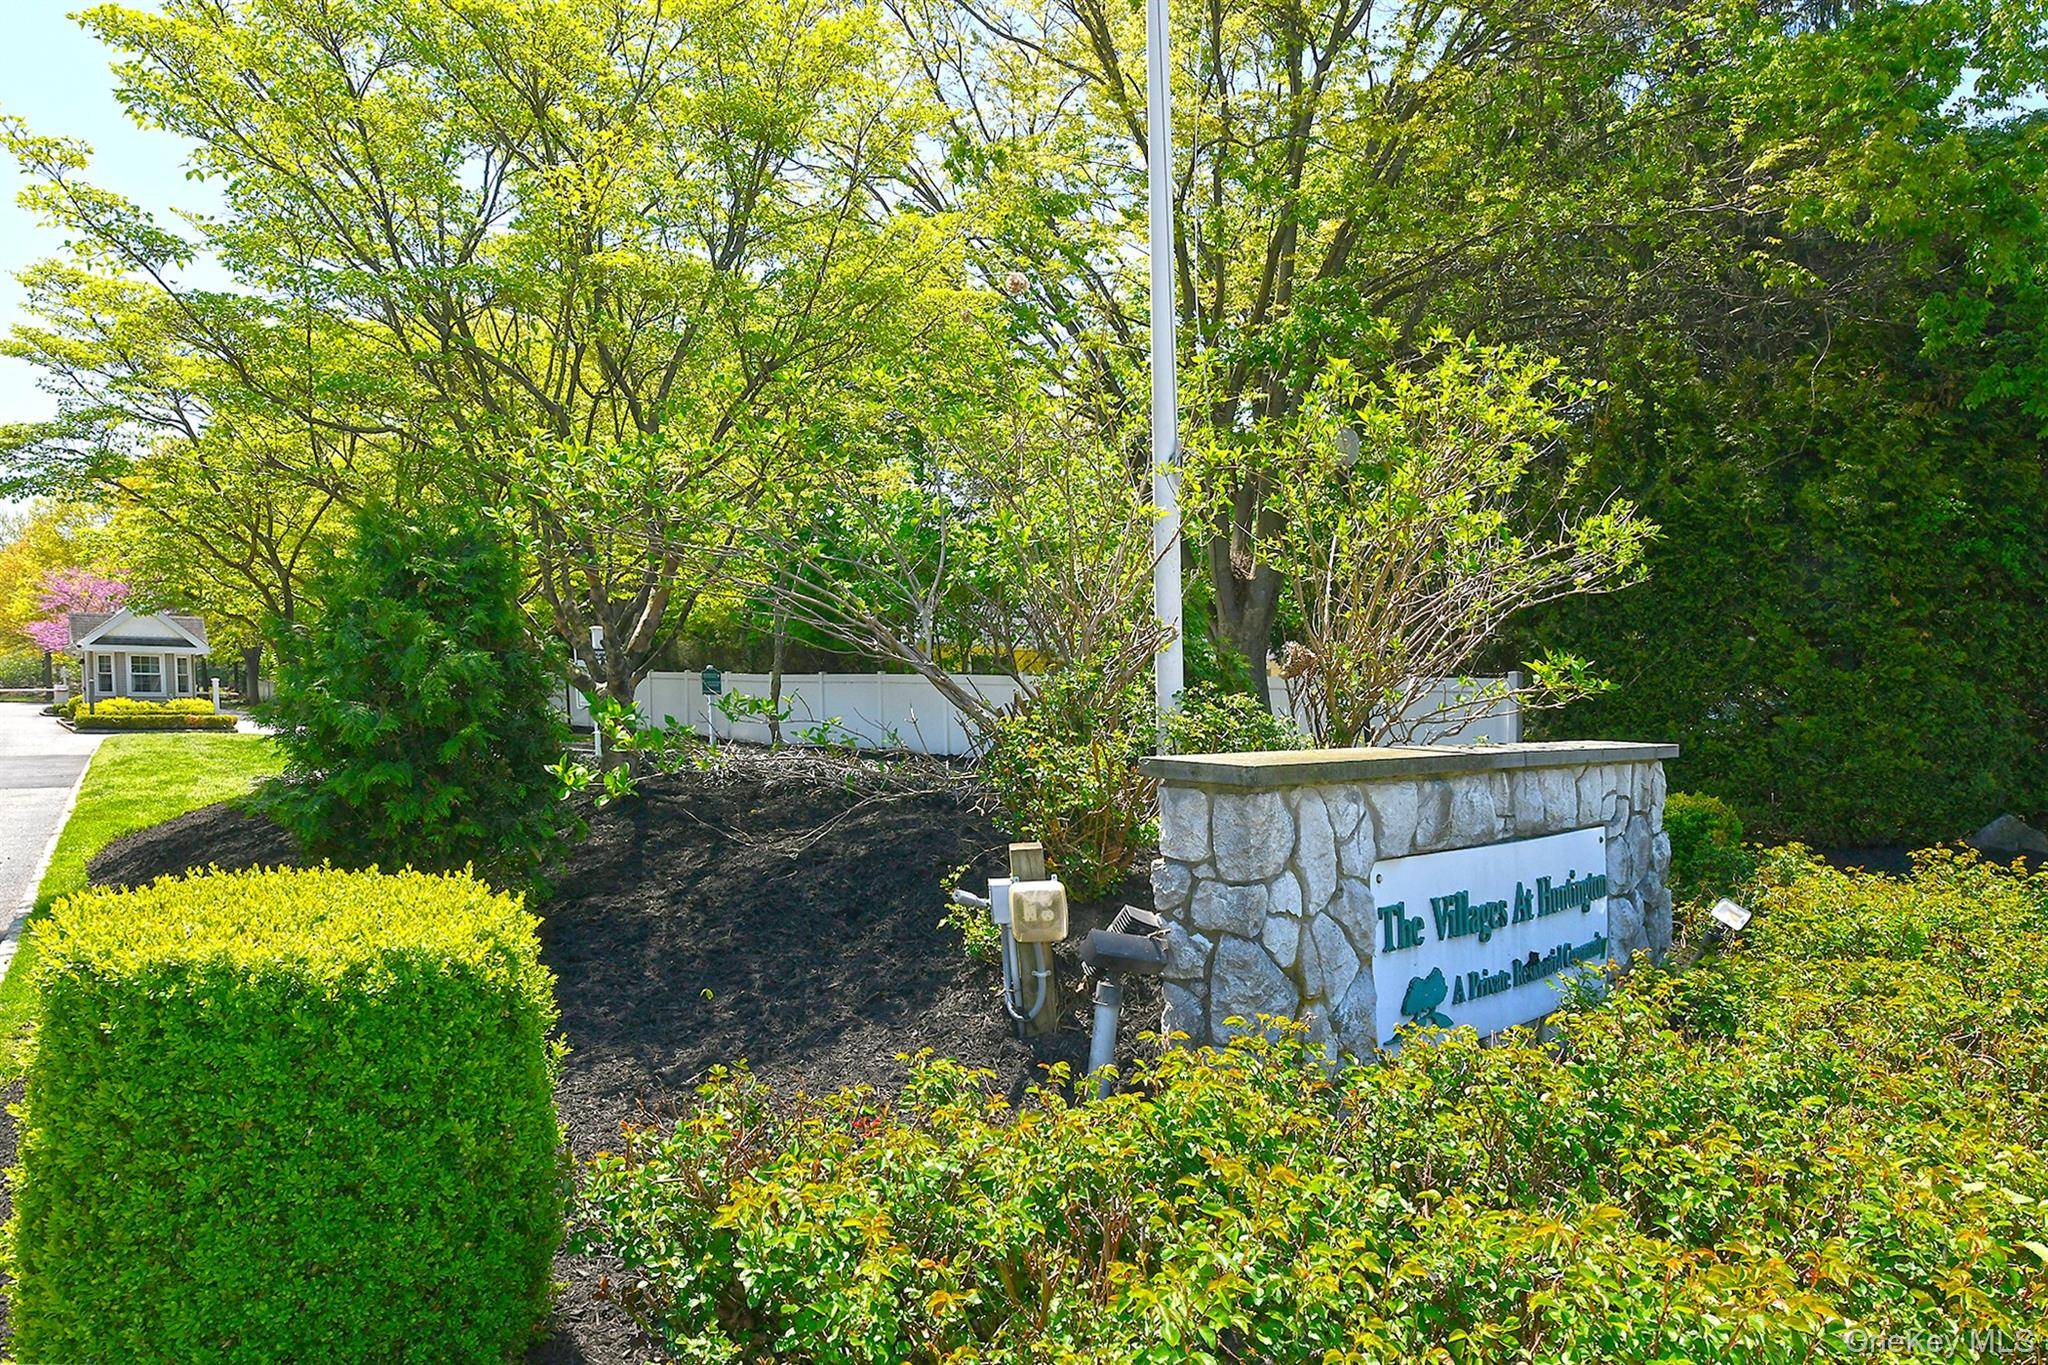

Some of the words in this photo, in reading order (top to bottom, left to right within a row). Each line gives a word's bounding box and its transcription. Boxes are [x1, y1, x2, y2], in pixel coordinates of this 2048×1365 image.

[1378, 902, 1425, 953] The
[1430, 890, 1508, 943] Villages
[1512, 881, 1534, 924] At
[1536, 869, 1606, 918] Huntington
[1452, 976, 1466, 1005] A
[1467, 969, 1511, 1000] Private
